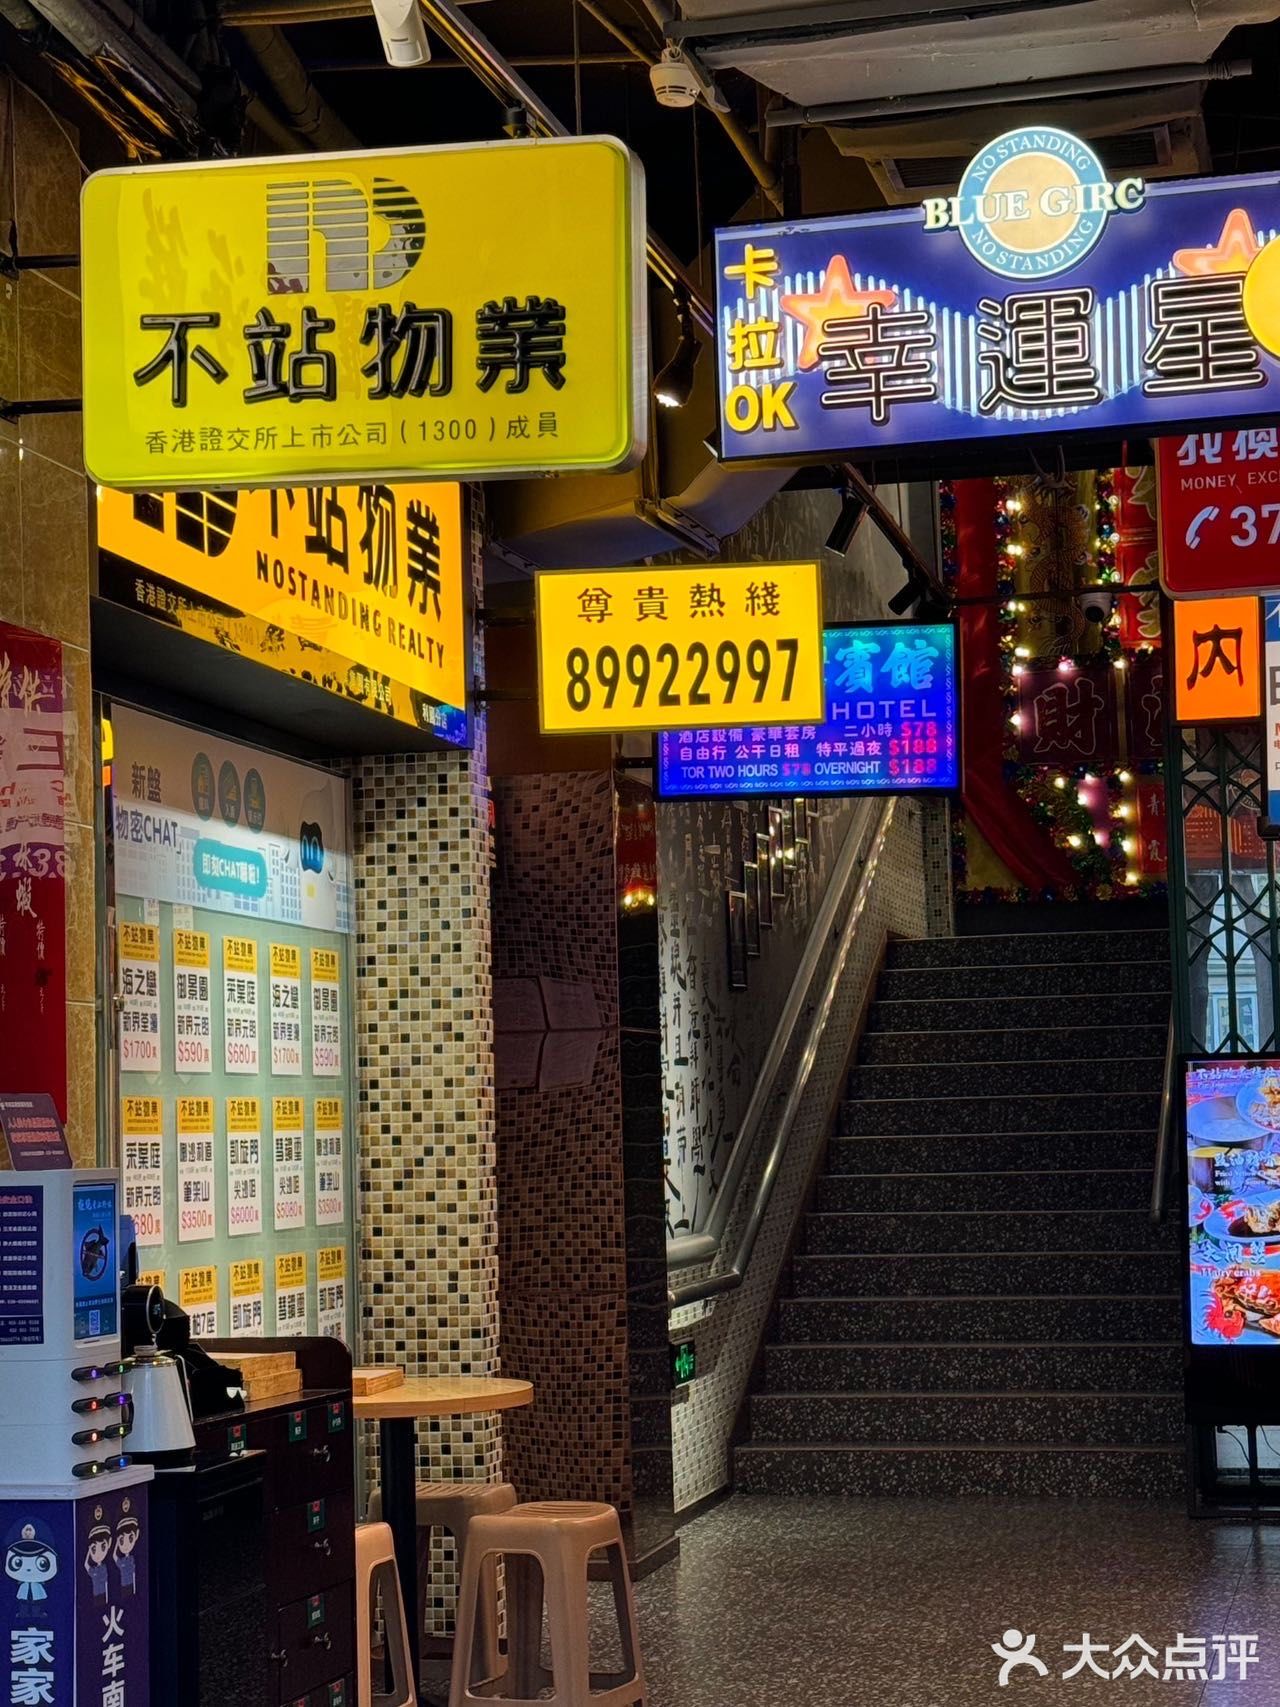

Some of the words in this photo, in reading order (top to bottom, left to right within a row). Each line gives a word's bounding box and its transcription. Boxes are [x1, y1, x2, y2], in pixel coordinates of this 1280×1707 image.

[972, 155, 997, 181] NO
[996, 134, 1091, 172] STANDING
[923, 189, 1030, 231] BLUE
[1039, 177, 1144, 216] GIRC
[972, 229, 996, 255] NO
[996, 219, 1093, 271] STANDING
[134, 296, 567, 408] 不站物業
[818, 272, 1267, 424] 幸運星
[1181, 473, 1236, 491] MONEY
[256, 550, 383, 638] NOSTANDING
[387, 617, 444, 668] REALTY
[566, 637, 800, 713] 89922997
[832, 699, 937, 720] HOTEL
[844, 723, 893, 738] 二小時
[901, 721, 937, 737] $78
[680, 745, 728, 761] 自由行
[816, 740, 882, 758] 特平過夜
[888, 739, 937, 756] $188
[681, 765, 705, 779] TOR
[708, 764, 735, 778] TWO
[738, 763, 778, 777] HOURS
[814, 760, 881, 776] OVERNIGHT
[888, 759, 937, 775] $188
[10, 1627, 55, 1706] 家家
